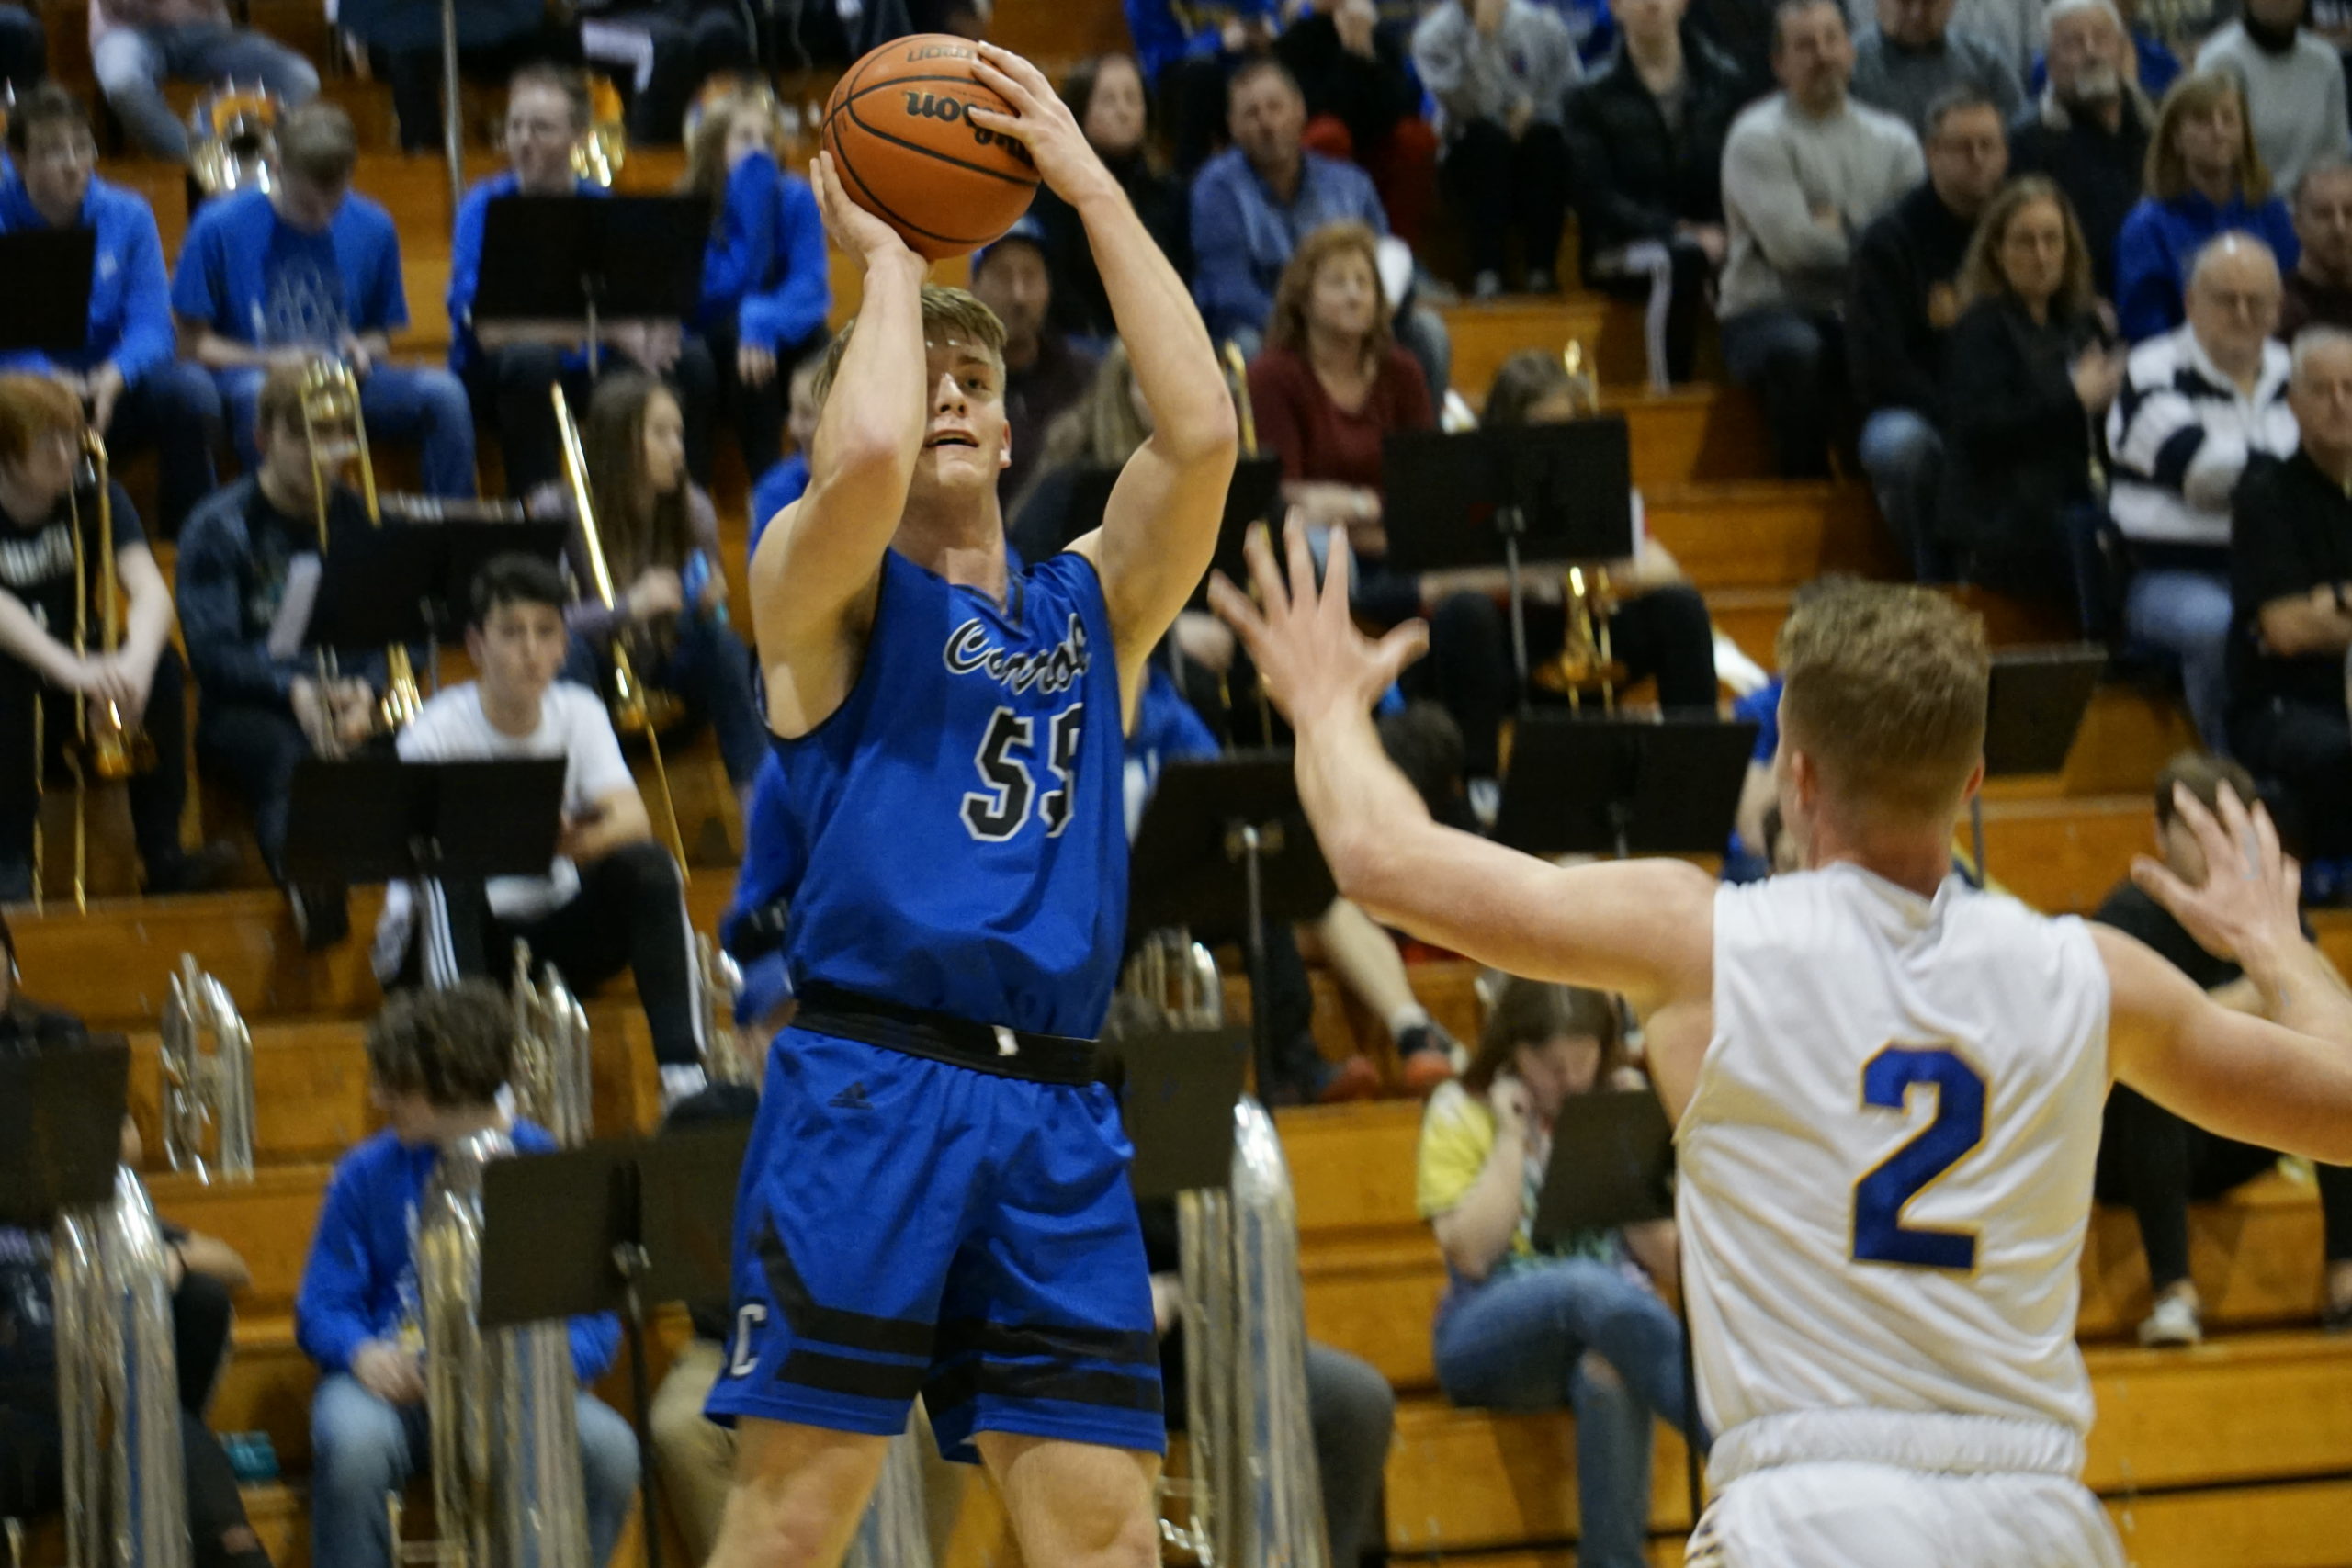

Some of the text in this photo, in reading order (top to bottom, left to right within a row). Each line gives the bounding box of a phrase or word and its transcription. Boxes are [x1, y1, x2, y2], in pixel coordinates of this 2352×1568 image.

[944, 612, 1091, 695] Carrol
[959, 702, 1083, 842] 55
[1849, 1041, 1991, 1281] 2
[730, 1300, 768, 1378] C
